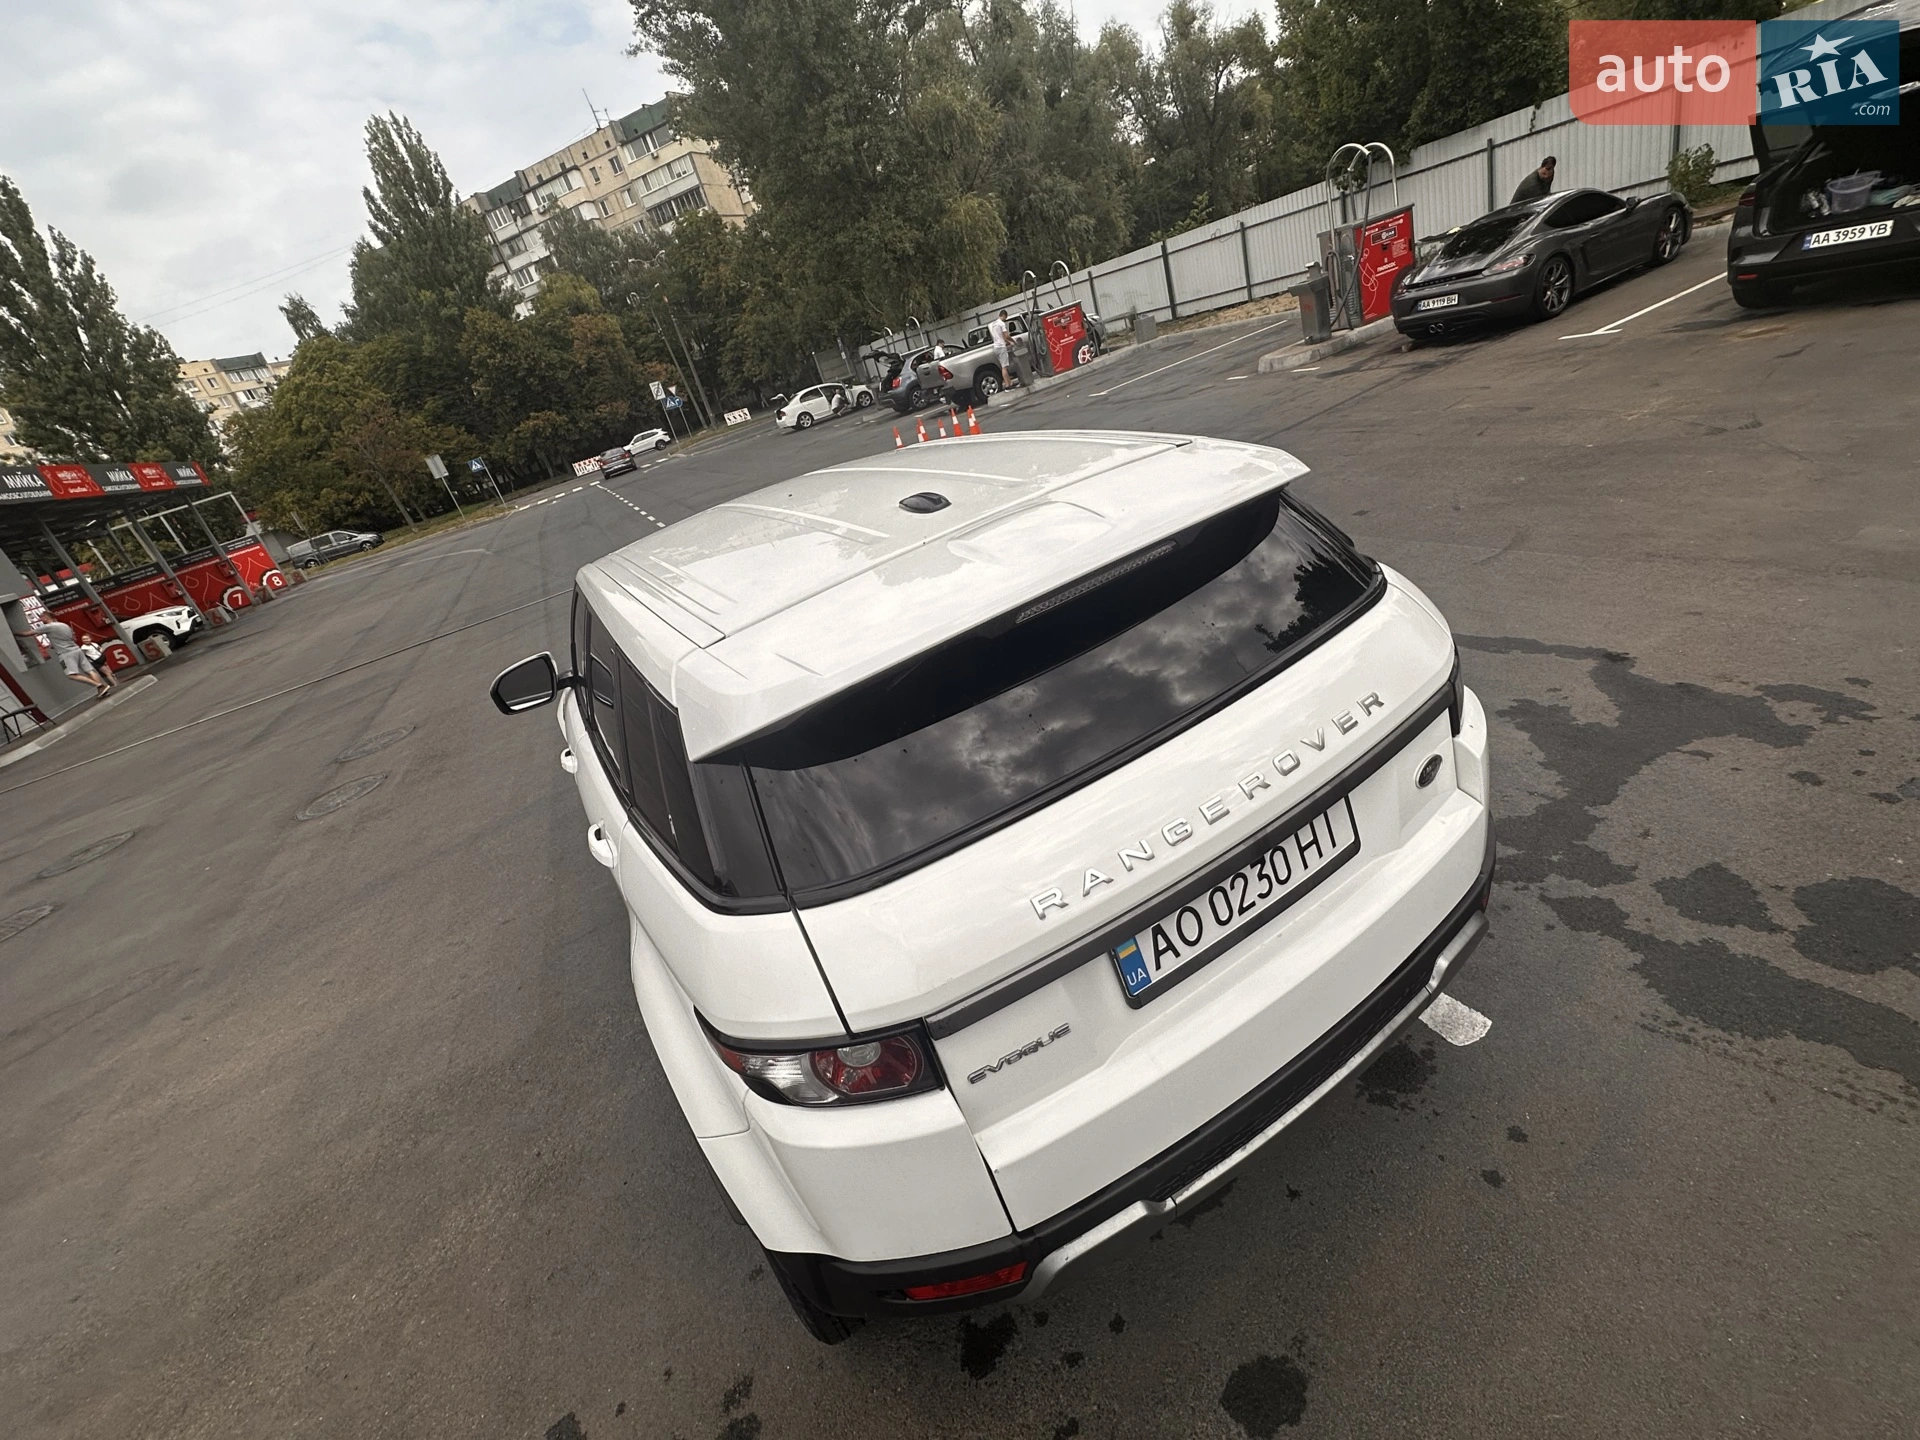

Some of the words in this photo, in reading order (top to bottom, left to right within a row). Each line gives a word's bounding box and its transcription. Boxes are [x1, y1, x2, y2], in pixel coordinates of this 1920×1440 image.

[1812, 233, 1830, 245] AA
[1833, 227, 1866, 242] 3959
[1869, 223, 1888, 237] YB
[2, 471, 46, 489] МИЙКА
[106, 468, 136, 482] МИЙКА
[272, 575, 283, 587] 8
[232, 592, 242, 606] 7
[113, 648, 129, 665] 5
[144, 640, 160, 657] 5
[1030, 795, 1230, 921] RANGE
[1237, 691, 1385, 801] ROVER
[1151, 905, 1203, 972] AO
[1208, 845, 1292, 926] 0230
[1294, 810, 1337, 871] HI
[1126, 966, 1147, 987] UA
